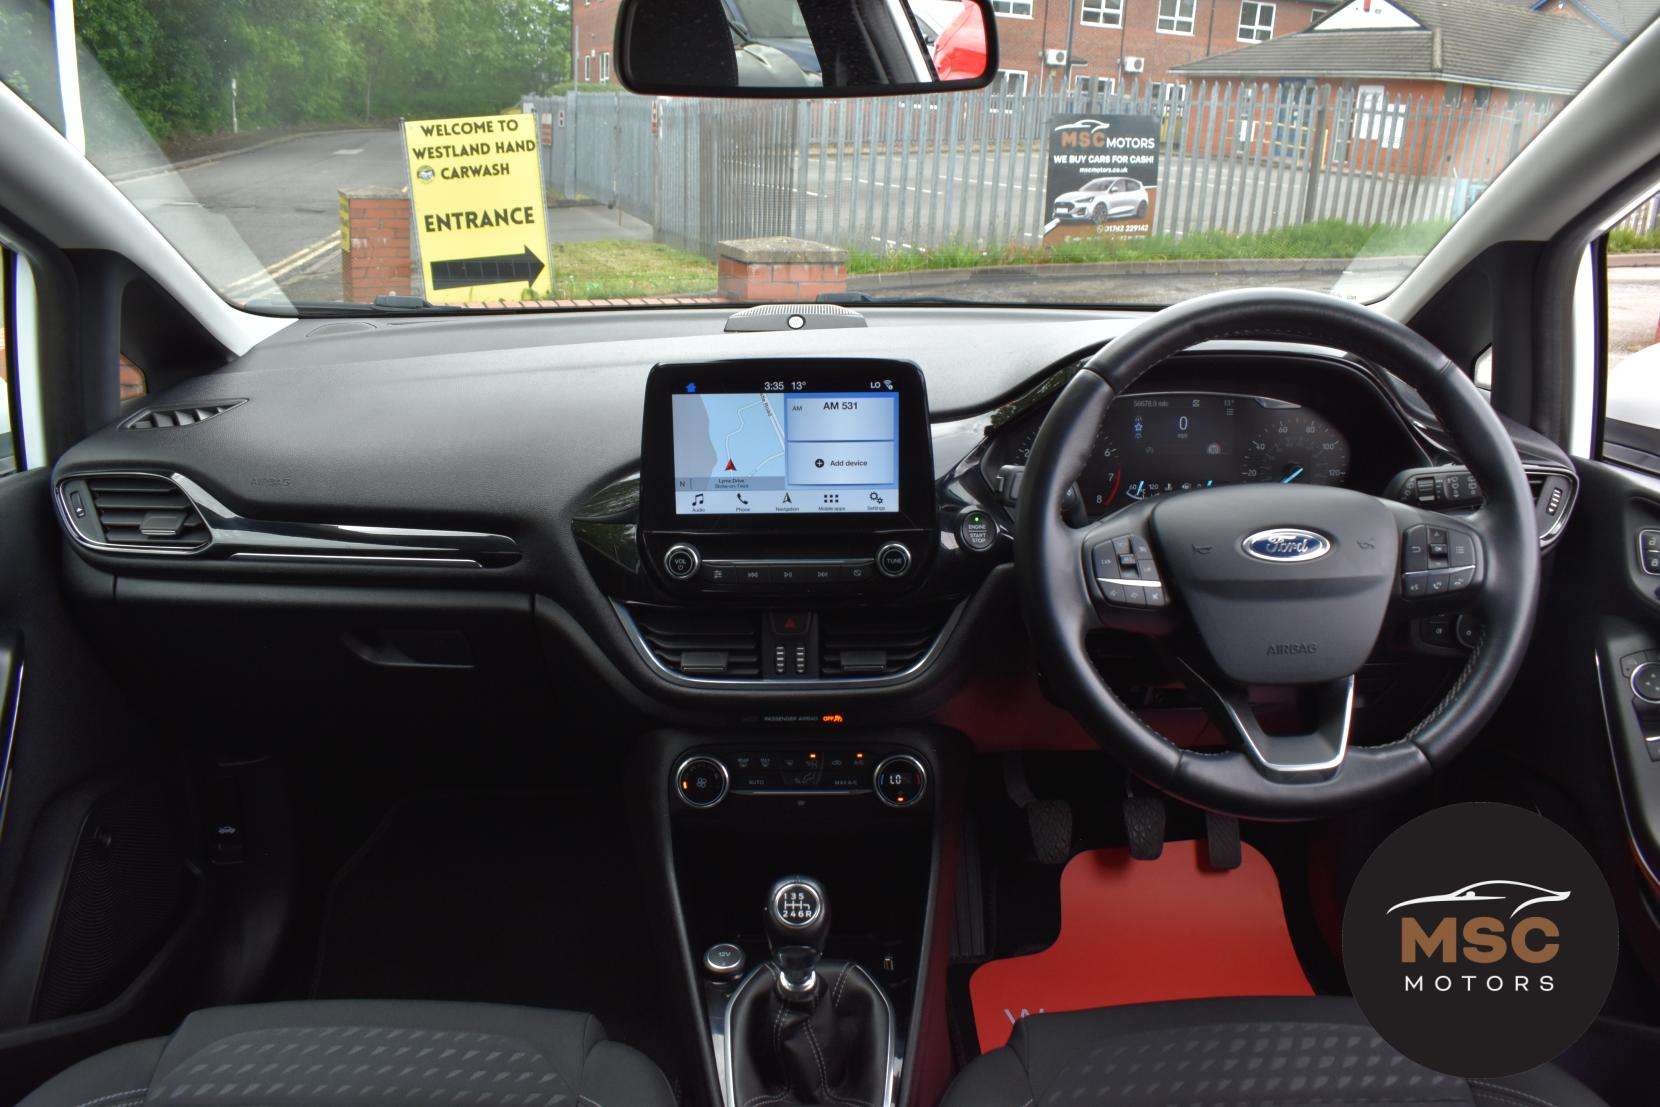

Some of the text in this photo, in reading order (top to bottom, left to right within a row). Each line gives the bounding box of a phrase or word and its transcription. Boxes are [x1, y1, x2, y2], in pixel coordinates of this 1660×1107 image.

[420, 119, 519, 137] WELCOME TO
[1061, 131, 1156, 149] MSC MOTORS
[412, 139, 536, 160] WESTLAND HAND
[1053, 154, 1067, 164] WE
[1068, 155, 1087, 164] BUY
[1088, 155, 1111, 164] CARS
[1111, 155, 1129, 164] FOR
[440, 163, 510, 180] CARWASH
[1079, 166, 1128, 174] mscmotors.co.uk
[423, 206, 535, 233] ENTRANCE
[764, 381, 807, 391] 3:35 13°
[870, 381, 881, 389] LO
[823, 401, 858, 410] AM 531
[1179, 416, 1188, 430] 0
[1104, 449, 1111, 457] 6
[830, 459, 868, 467] Add device
[679, 480, 686, 488] N
[1266, 534, 1309, 553] Ford
[1267, 643, 1317, 656] AIRBAG
